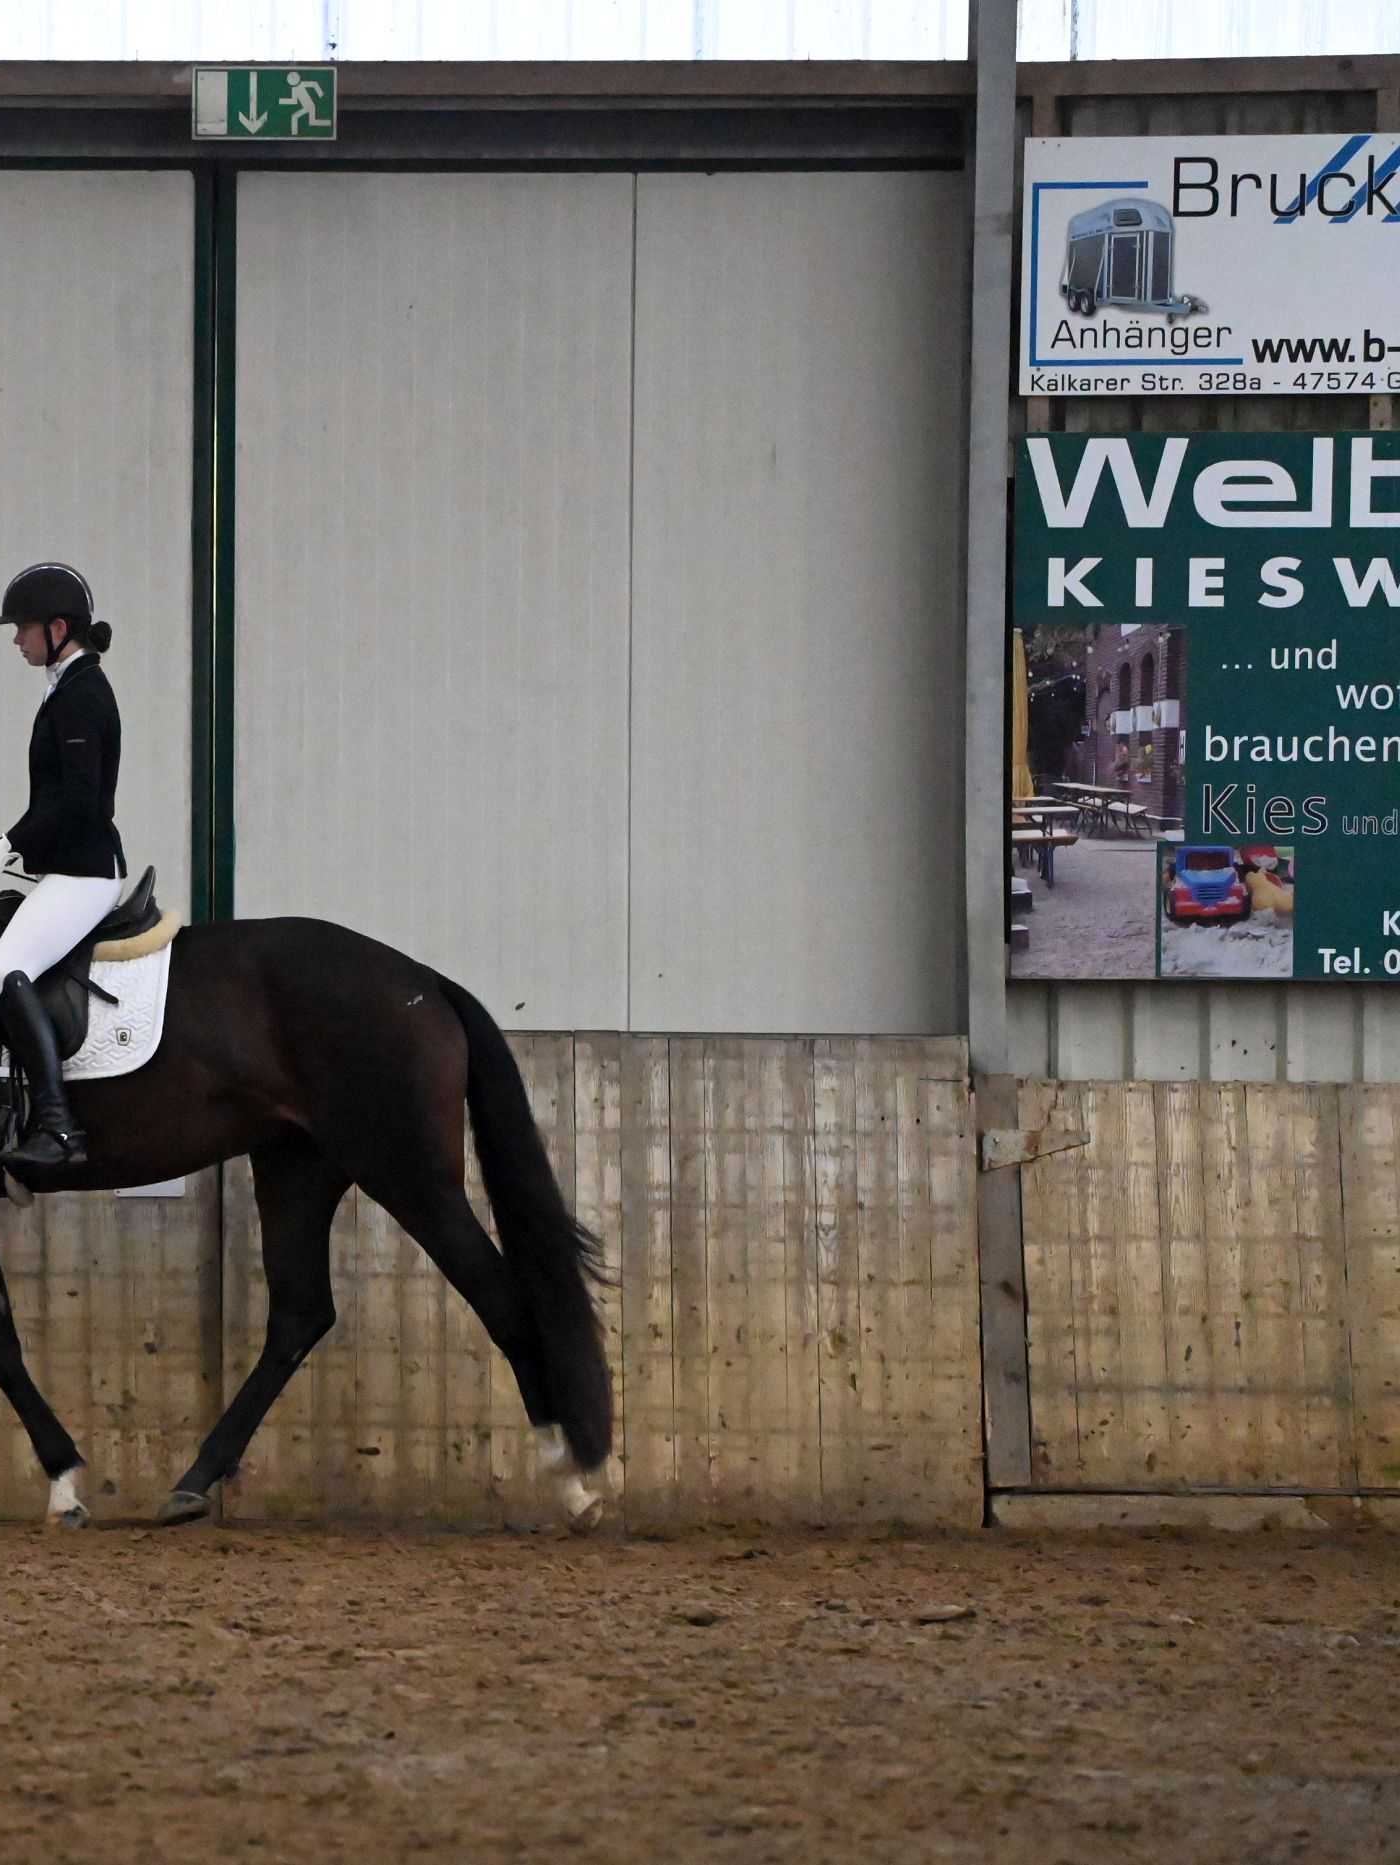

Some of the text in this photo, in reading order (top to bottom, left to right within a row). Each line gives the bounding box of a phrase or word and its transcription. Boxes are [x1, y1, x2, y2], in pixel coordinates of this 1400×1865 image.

[1050, 319, 1232, 355] Anhänger
[1030, 374, 1130, 392] Kalkarer
[1141, 373, 1184, 391] Str.
[1198, 373, 1261, 391] 328a
[1292, 372, 1376, 390] 47574
[1047, 556, 1400, 608] KIESW
[1270, 639, 1337, 670] und
[1335, 683, 1400, 710] wo
[1202, 783, 1399, 836] Kies und
[1318, 947, 1371, 974] Tel.
